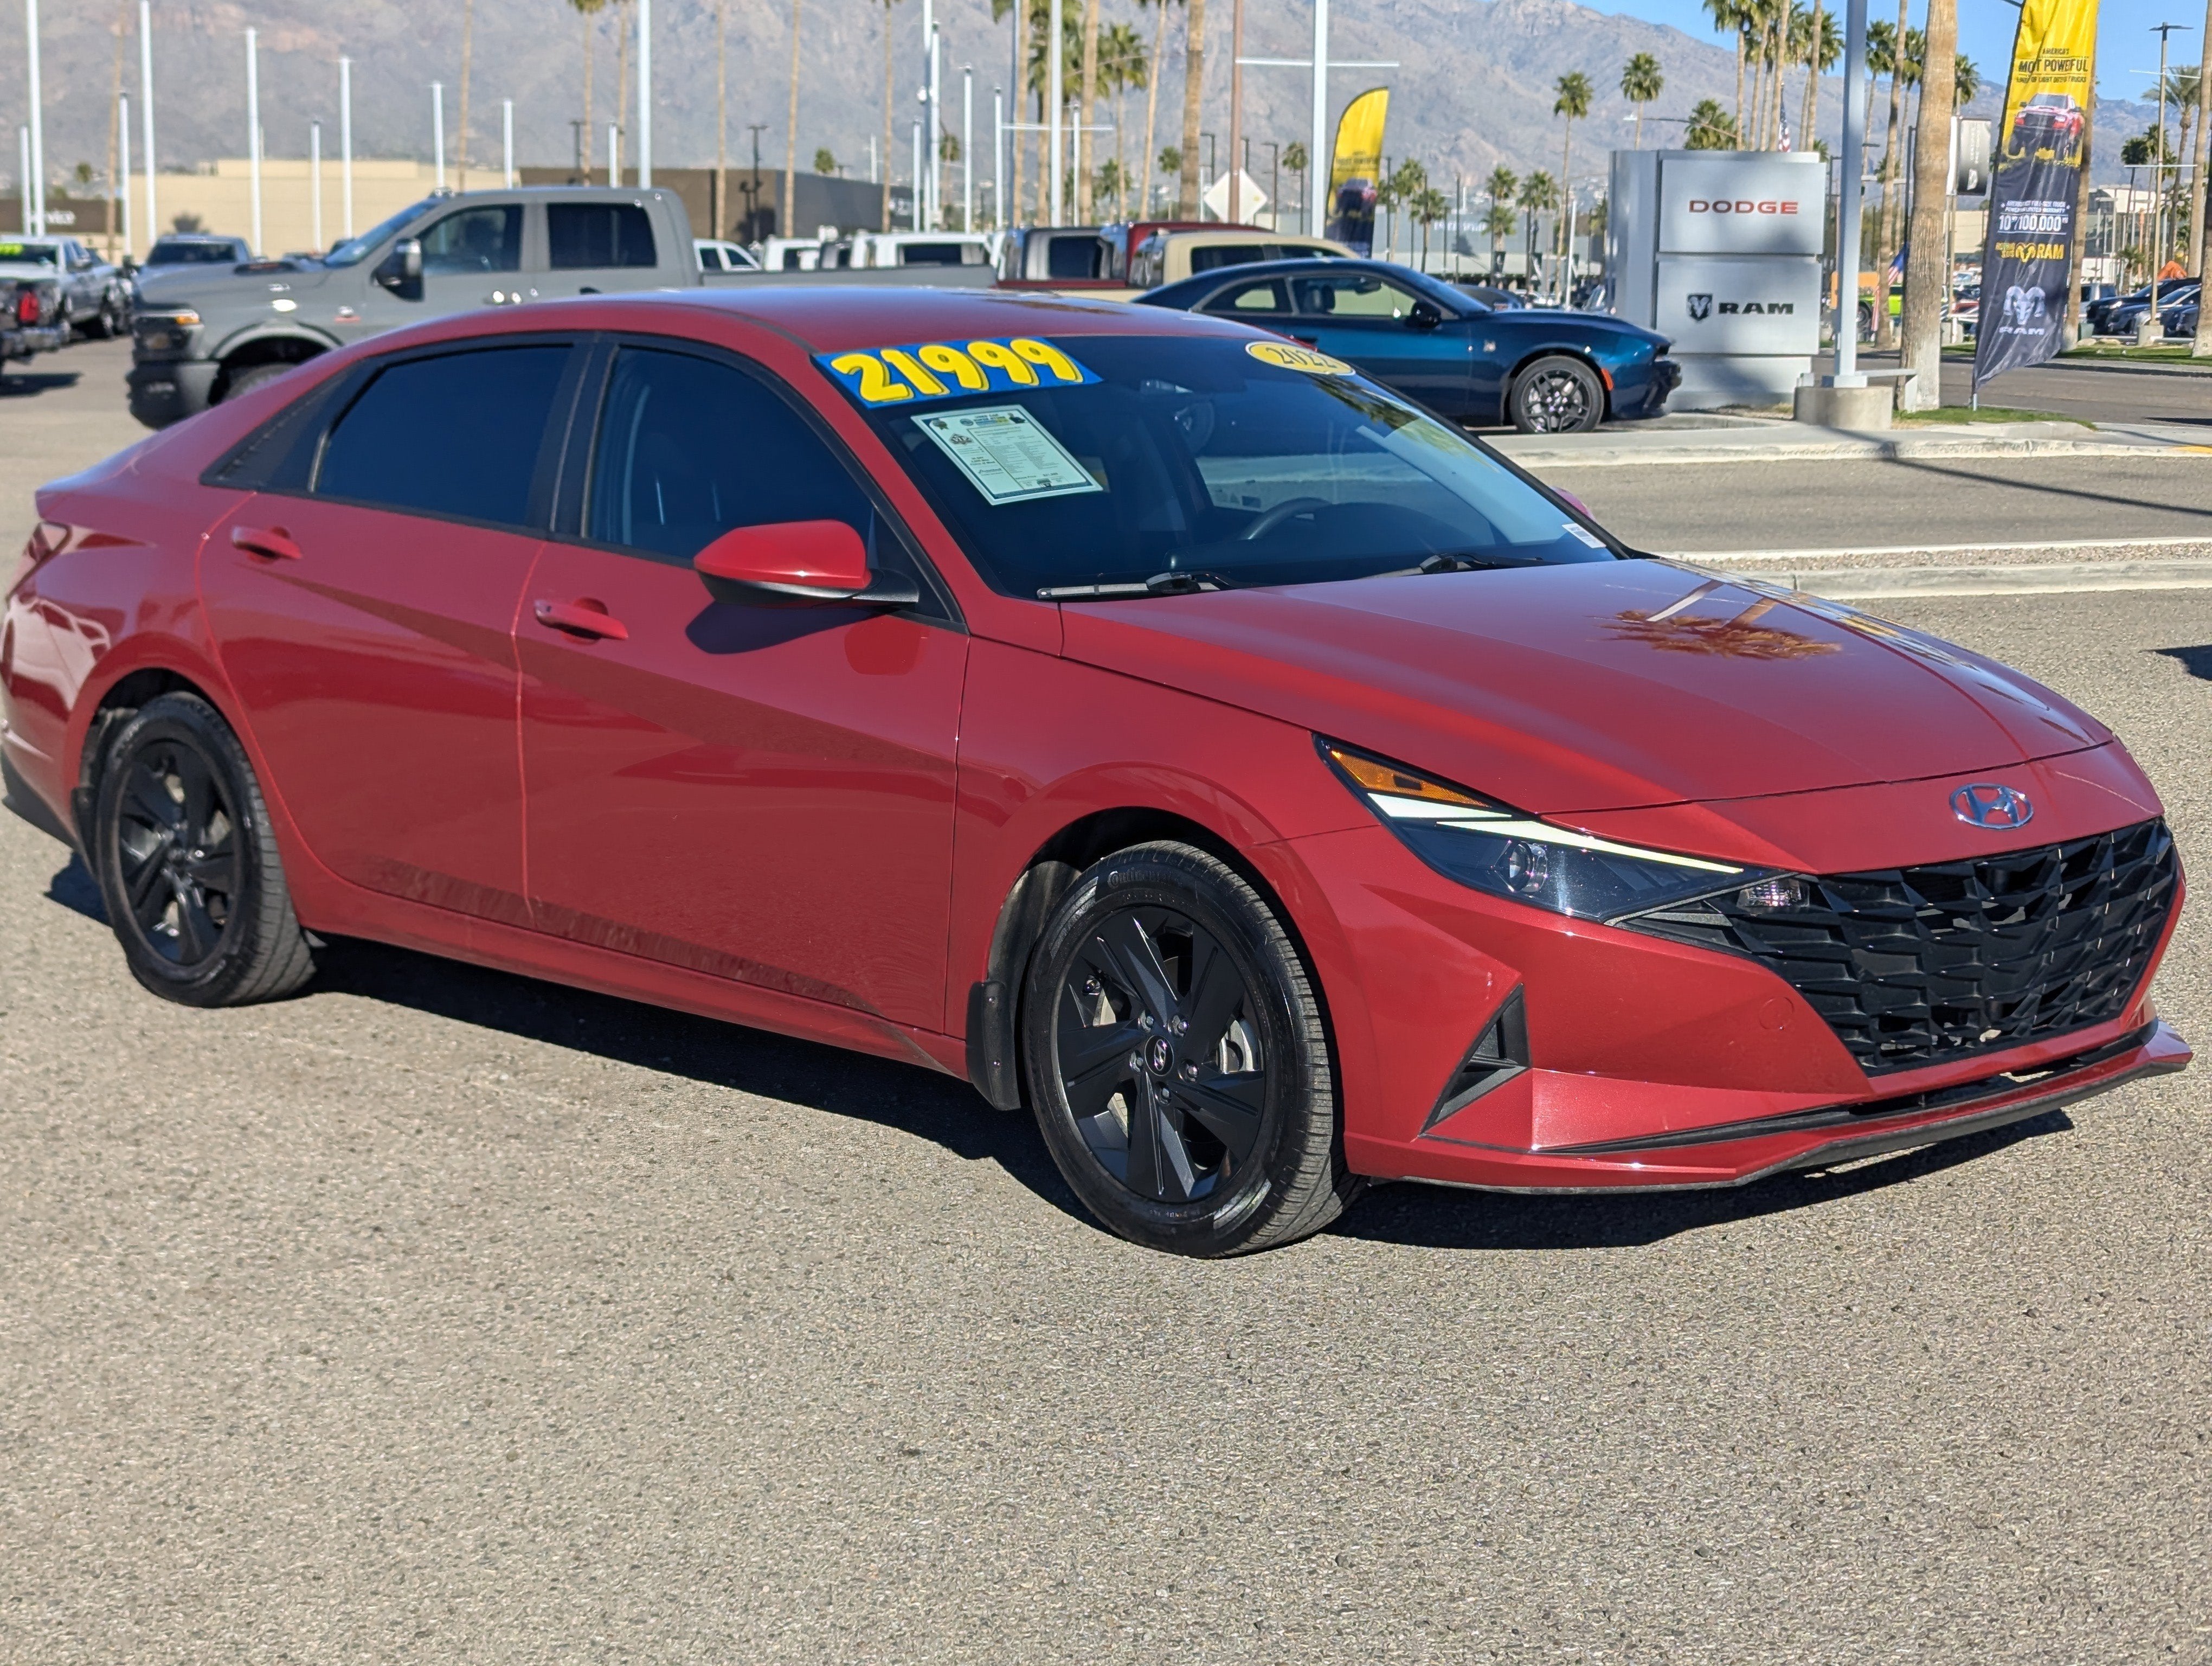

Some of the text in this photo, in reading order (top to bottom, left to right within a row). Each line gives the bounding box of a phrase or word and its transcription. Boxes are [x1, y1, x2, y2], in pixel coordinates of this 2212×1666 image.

[2018, 58, 2088, 73] MOT POWEFUL
[1688, 200, 1799, 215] DODGE
[2036, 243, 2065, 260] RAM
[1718, 302, 1795, 315] RAM
[1998, 326, 2045, 335] RAM
[1264, 347, 1338, 369] 2022
[830, 338, 1084, 402] 21999
